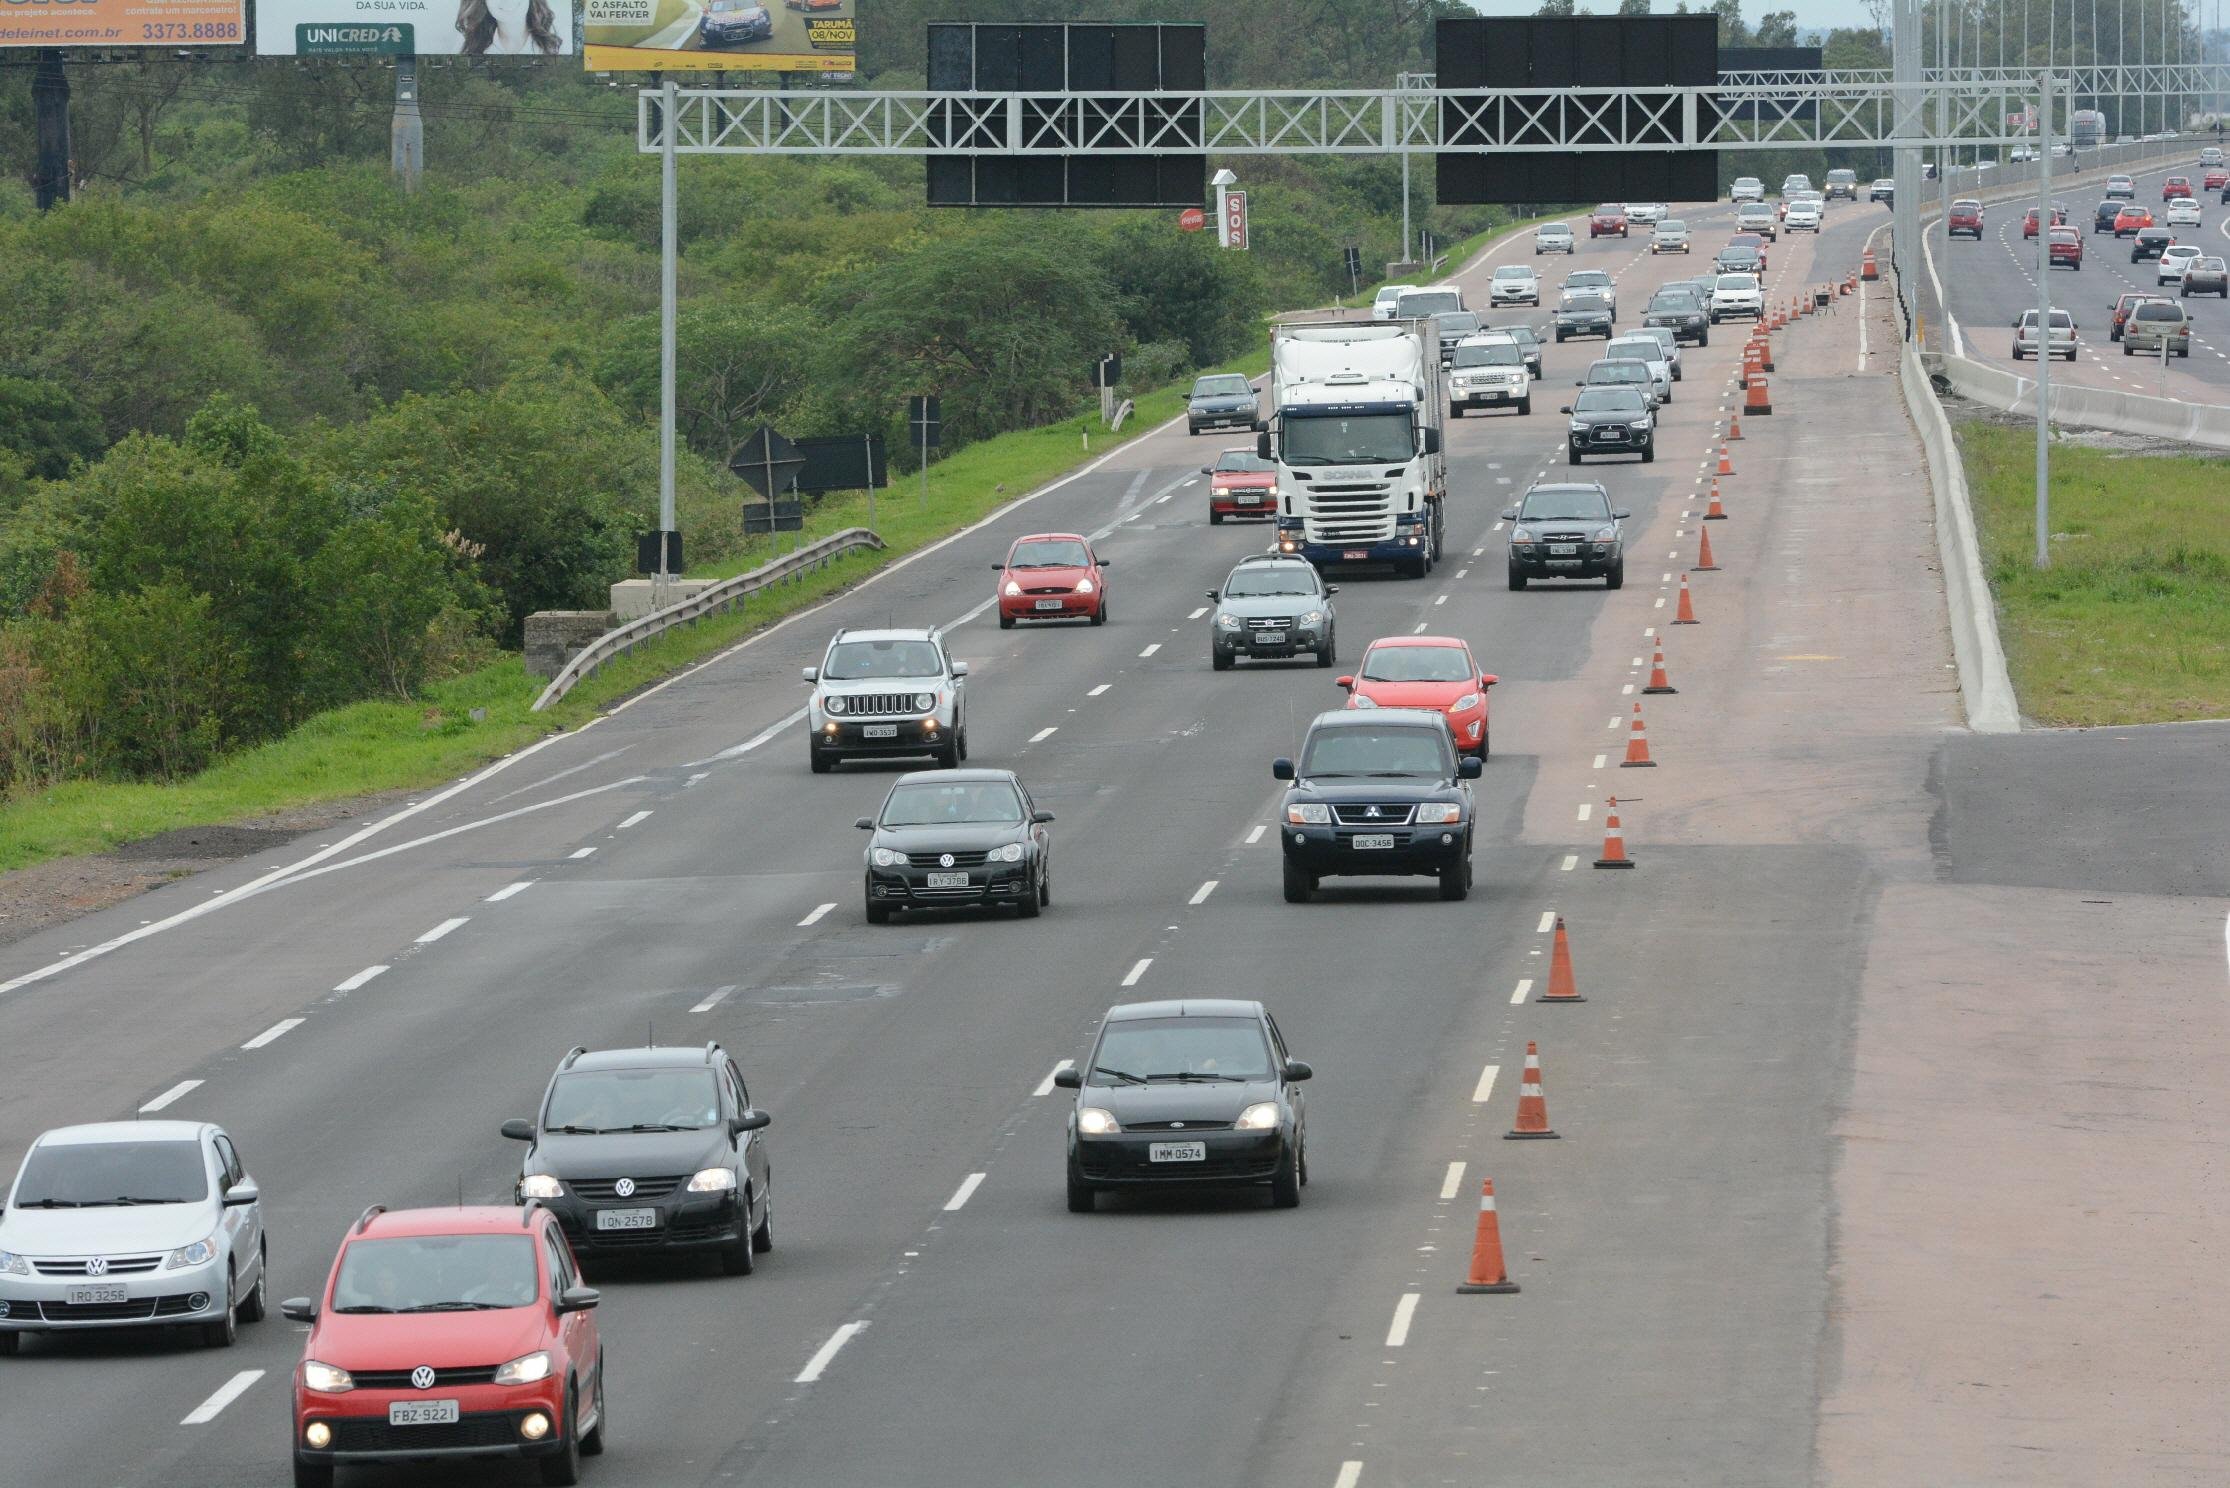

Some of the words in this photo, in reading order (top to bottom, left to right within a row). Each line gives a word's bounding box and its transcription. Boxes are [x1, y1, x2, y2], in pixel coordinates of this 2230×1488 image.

[356, 1, 372, 9] DA
[374, 1, 397, 9] SUA
[591, 1, 599, 9] O
[602, 1, 648, 9] ASFALTO
[590, 10, 607, 18] VAI
[609, 10, 650, 19] FERVER
[142, 22, 238, 39] 3373.8888
[307, 28, 379, 42] UNICRED
[812, 31, 852, 39] 08/NOV
[1229, 198, 1241, 244] SOS
